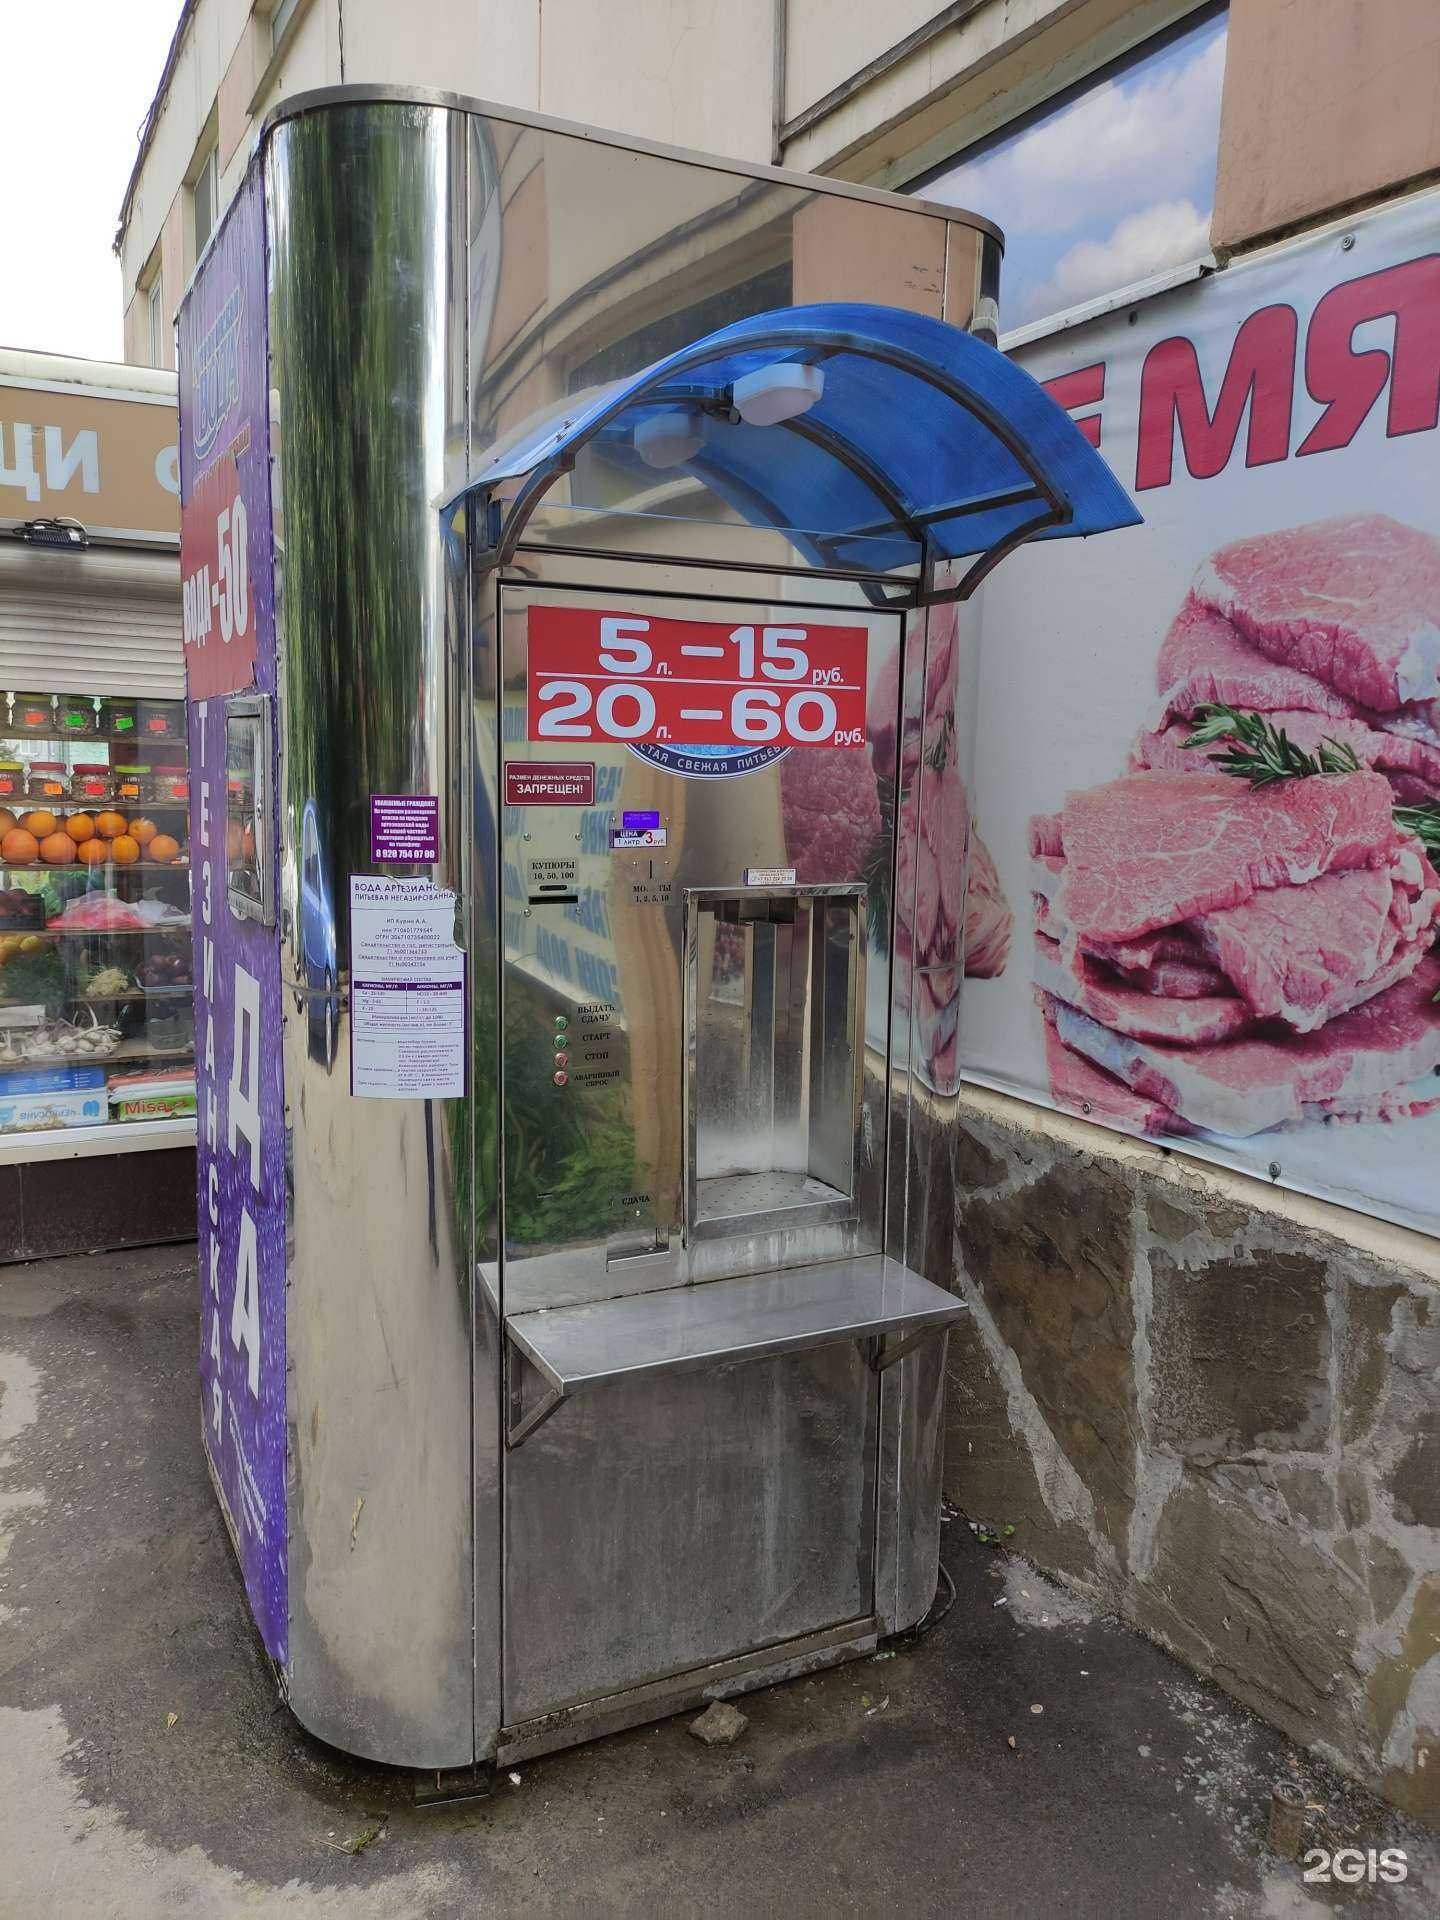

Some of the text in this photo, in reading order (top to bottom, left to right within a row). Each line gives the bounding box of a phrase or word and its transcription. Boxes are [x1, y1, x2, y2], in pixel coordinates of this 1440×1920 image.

[812, 667, 844, 685] руб.
[834, 727, 865, 746] руб.
[677, 758, 728, 772] СВЕЖАЯ
[532, 774, 565, 782] ДЕНЕЖНЫХ
[516, 783, 584, 796] ЗАПРЕЩЕН!
[645, 831, 653, 844] 3
[532, 861, 575, 870] КУПЮРЫ
[533, 872, 545, 881] 10,
[546, 872, 558, 880] 50,
[354, 883, 381, 892] ВОДА
[354, 893, 388, 901] ПИТЬЕВАЯ
[577, 1003, 615, 1014] ВЫДАТЬ
[581, 1014, 611, 1024] СДАЧУ
[582, 1032, 611, 1041] СТАРТ
[585, 1052, 609, 1060] СТОП
[622, 1195, 651, 1206] СДАЧА
